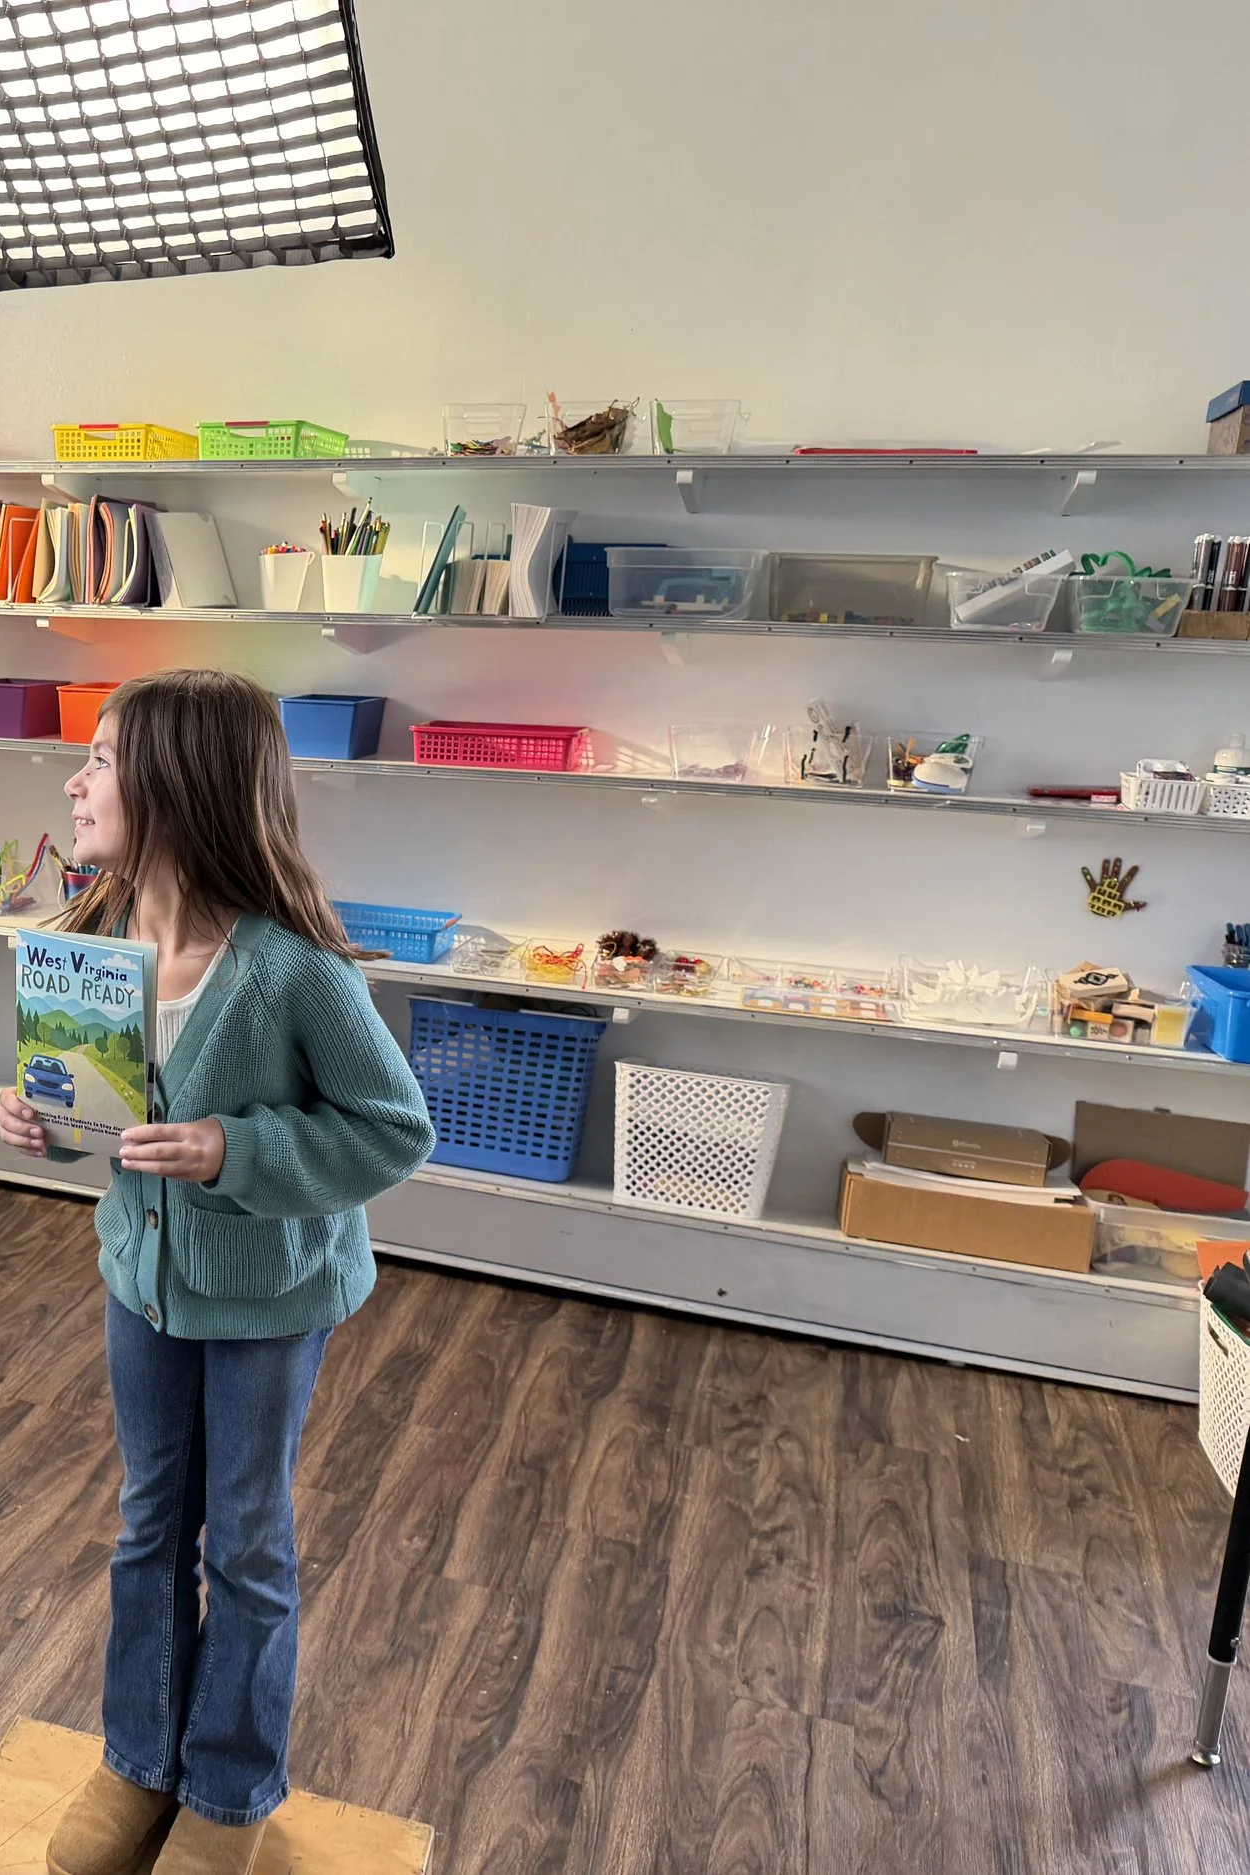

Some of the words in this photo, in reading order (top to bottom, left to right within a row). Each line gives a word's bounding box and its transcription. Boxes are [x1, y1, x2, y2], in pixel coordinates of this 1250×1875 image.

[26, 944, 67, 971] West
[70, 951, 127, 982] Virginia
[21, 963, 70, 994] ROAD
[81, 978, 134, 1008] READY
